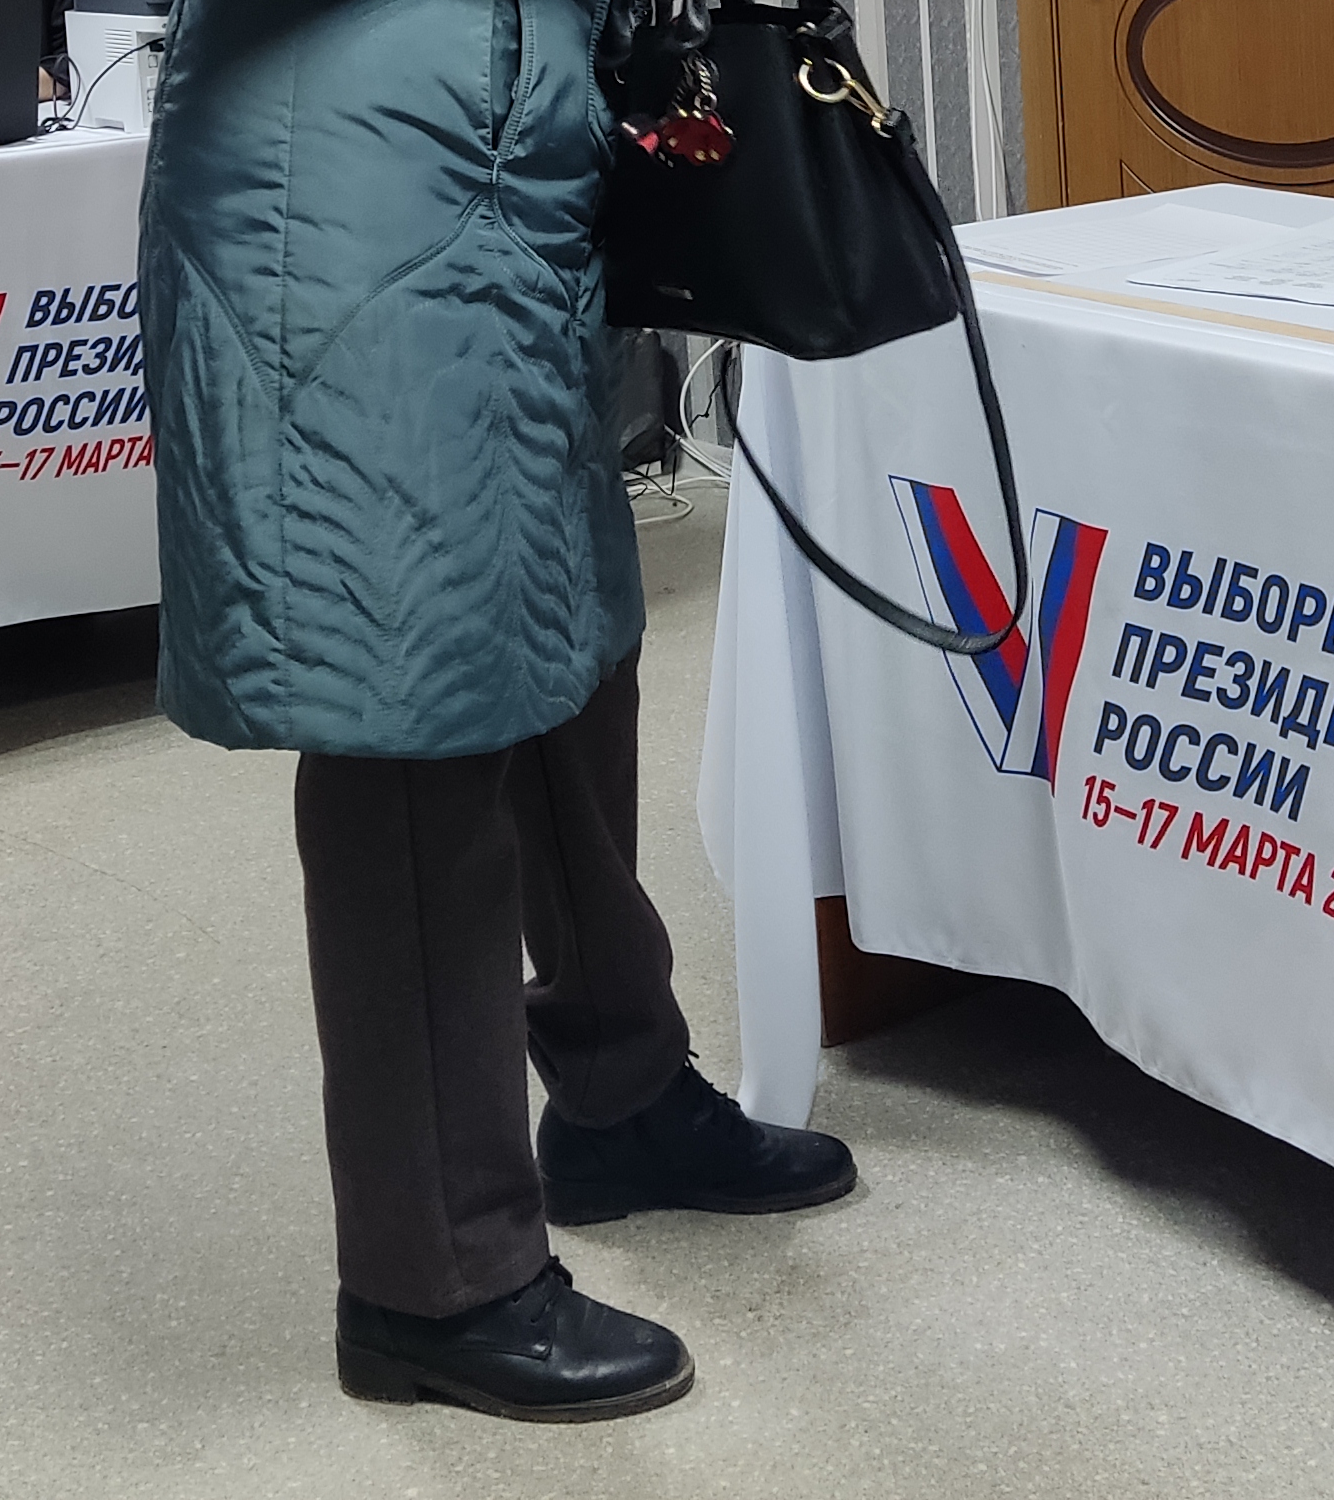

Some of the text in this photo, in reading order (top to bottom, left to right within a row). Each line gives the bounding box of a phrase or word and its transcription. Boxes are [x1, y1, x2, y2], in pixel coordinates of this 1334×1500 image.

[54, 435, 154, 478] МАРТА
[1093, 700, 1311, 822] РОССИИ
[1180, 811, 1315, 906] МАРТА
